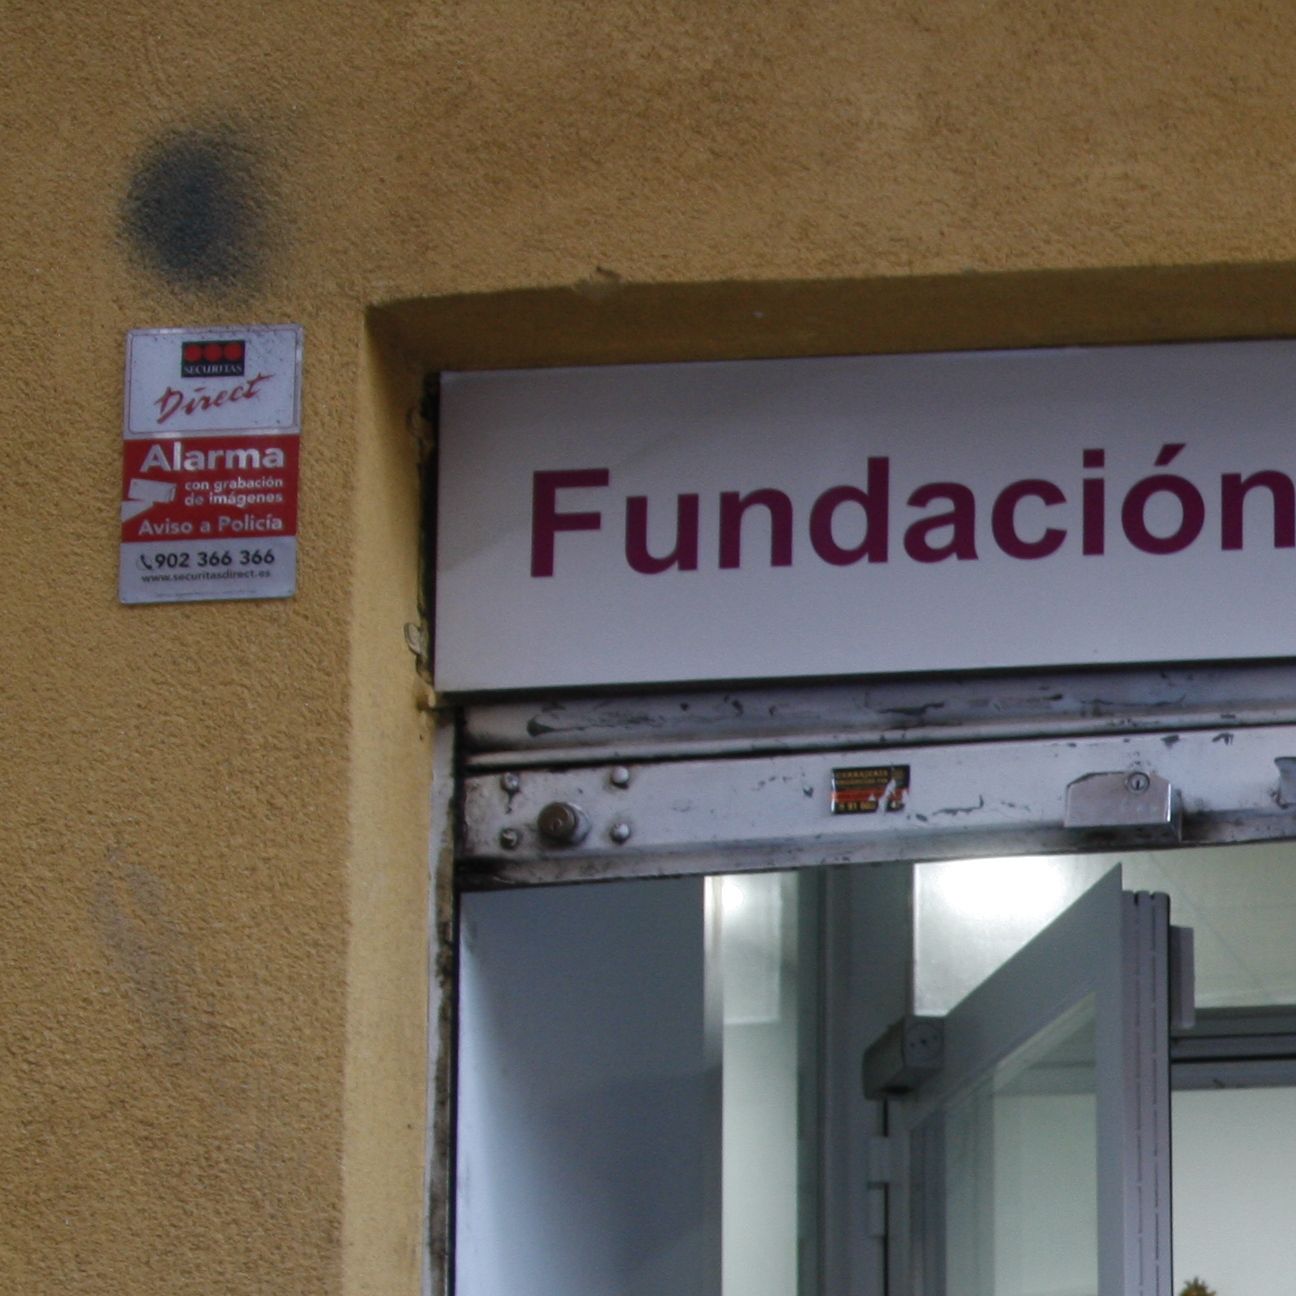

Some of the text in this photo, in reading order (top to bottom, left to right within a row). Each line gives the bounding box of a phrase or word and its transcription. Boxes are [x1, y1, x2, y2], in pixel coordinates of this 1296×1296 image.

[183, 364, 243, 376] SECURITAS
[154, 373, 275, 424] Direct
[140, 441, 285, 473] Alarma
[185, 476, 283, 494] con grabación
[184, 490, 283, 509] de imágenes
[536, 448, 1294, 576] Fundación
[138, 513, 283, 535] Aviso a Policía
[154, 549, 275, 569] 902 366 366
[141, 569, 271, 583] www.securitasdirect.es
